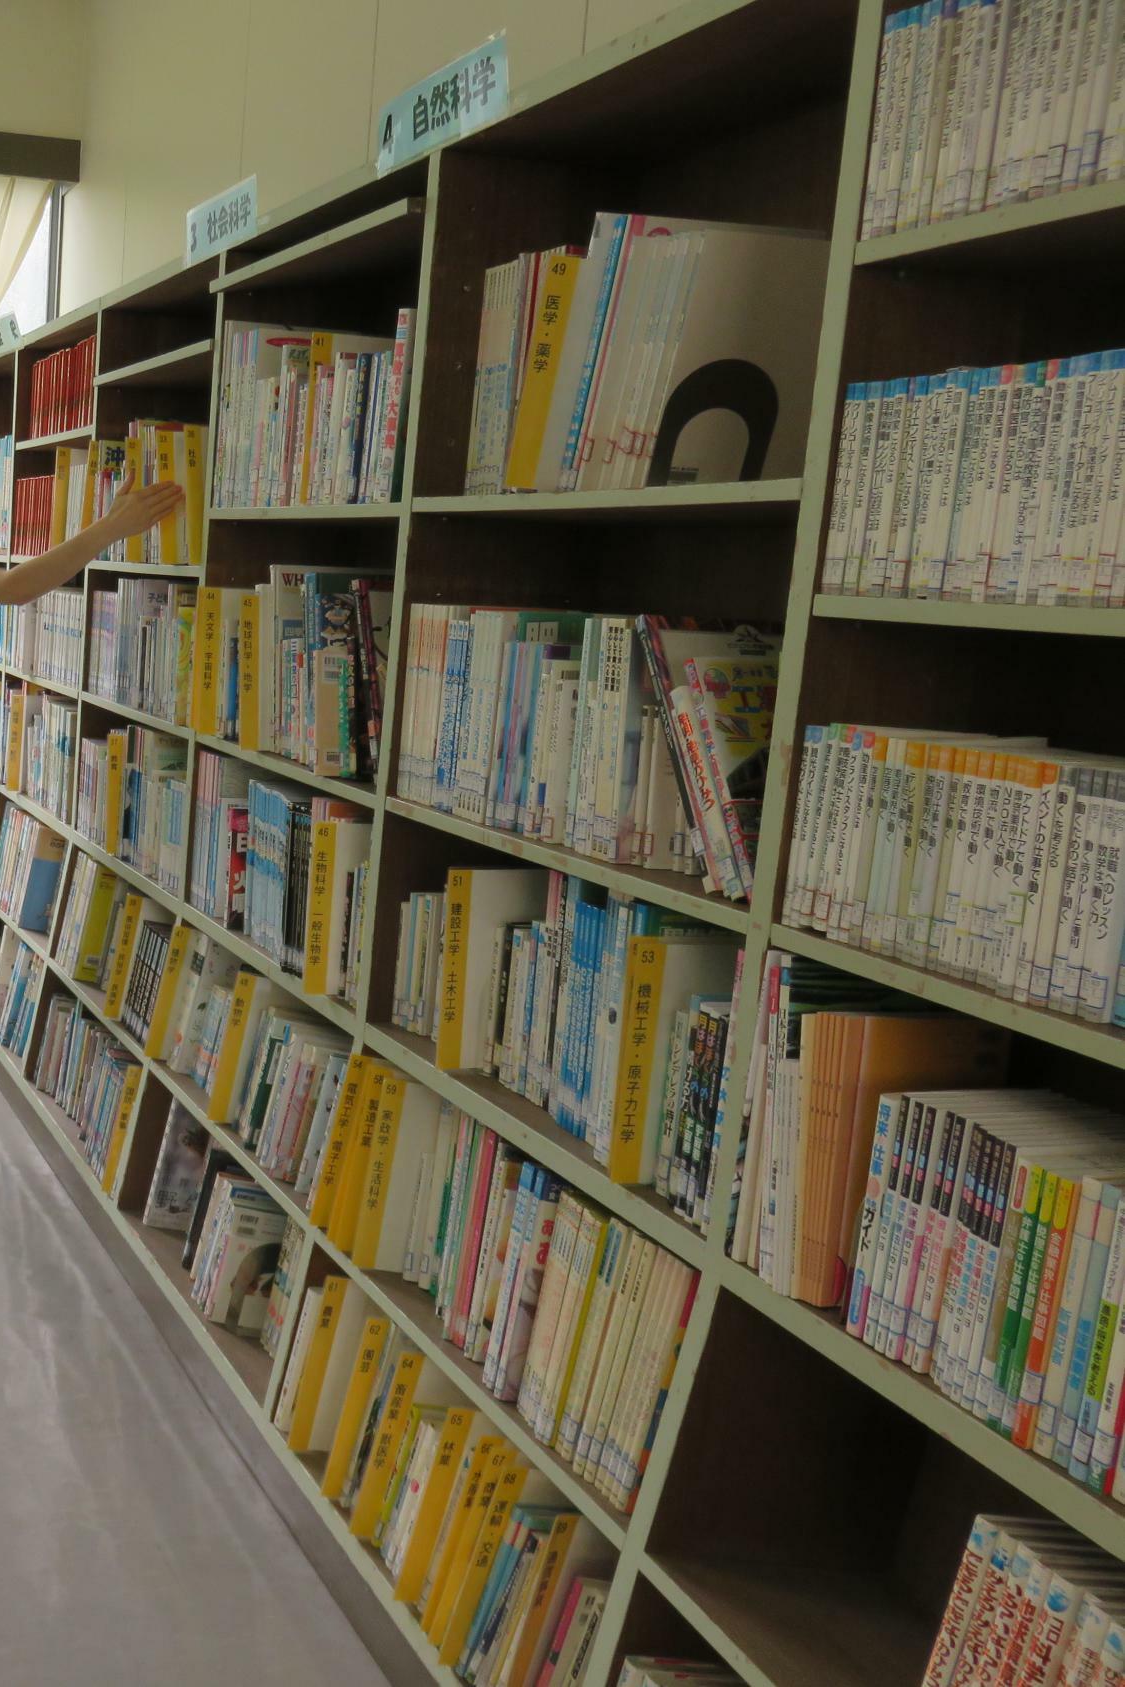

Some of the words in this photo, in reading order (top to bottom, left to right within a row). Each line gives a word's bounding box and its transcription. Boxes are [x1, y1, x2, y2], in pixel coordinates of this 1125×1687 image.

[381, 112, 397, 155] 4
[412, 56, 497, 140] 自然科学
[190, 223, 199, 253] 3
[207, 194, 252, 245] 社会科学
[551, 262, 567, 276] 49
[314, 338, 324, 347] 41
[533, 295, 562, 373] 医学・薬学
[206, 592, 215, 601] 44
[203, 612, 216, 690] 天文学・宇宙科学
[242, 620, 253, 692] 地球科学・地学
[318, 828, 329, 837] 46
[1028, 789, 1051, 905] イベントの仕事で働く
[452, 876, 464, 887] 51
[309, 852, 328, 966] 生物科学・一般生物学
[175, 930, 184, 938] 47
[444, 902, 463, 1024] 建設工学・土木工学
[641, 950, 655, 964] 53
[232, 997, 245, 1027] 動物学
[353, 1060, 363, 1070] 54
[620, 984, 653, 1144] 機械工学・原子力工学
[386, 1084, 397, 1095] 59
[323, 1083, 358, 1188] 電気工学・電子工学
[367, 1110, 393, 1210] 家政学・生活科学
[860, 1207, 876, 1252] ガイド
[327, 1281, 338, 1292] 61
[369, 1324, 381, 1336] 62
[402, 1358, 414, 1369] 64
[374, 1384, 407, 1470] 畜産業・獣医学
[451, 1414, 463, 1425] 65
[439, 1441, 456, 1466] 林業
[492, 1455, 505, 1467] 67
[504, 1473, 516, 1485] 68
[476, 1503, 508, 1568] 運輸・交通
